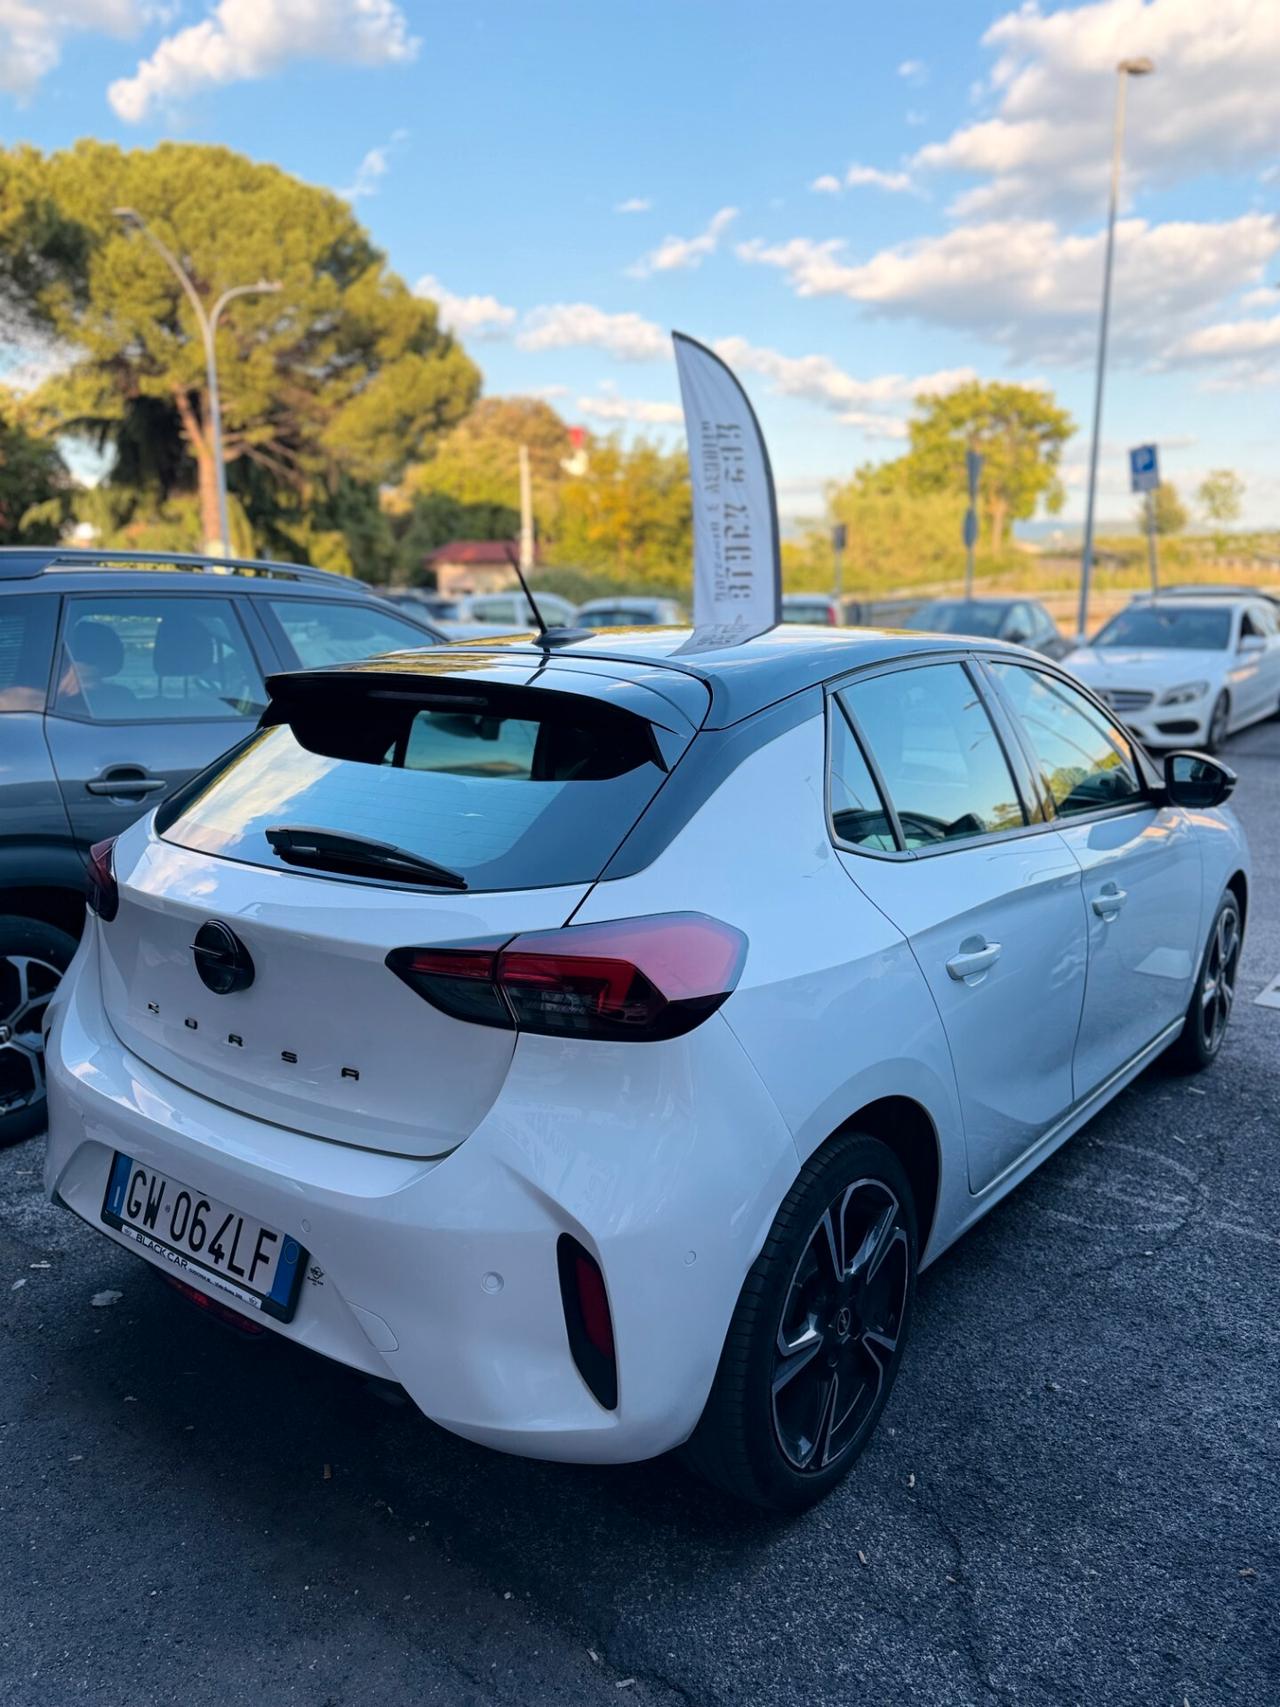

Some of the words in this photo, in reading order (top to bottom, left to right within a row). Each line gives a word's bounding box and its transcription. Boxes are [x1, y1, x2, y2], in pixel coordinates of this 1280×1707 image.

[148, 1001, 360, 1081] CORSA
[136, 1234, 167, 1258] BLACK
[167, 1252, 188, 1270] CAR
